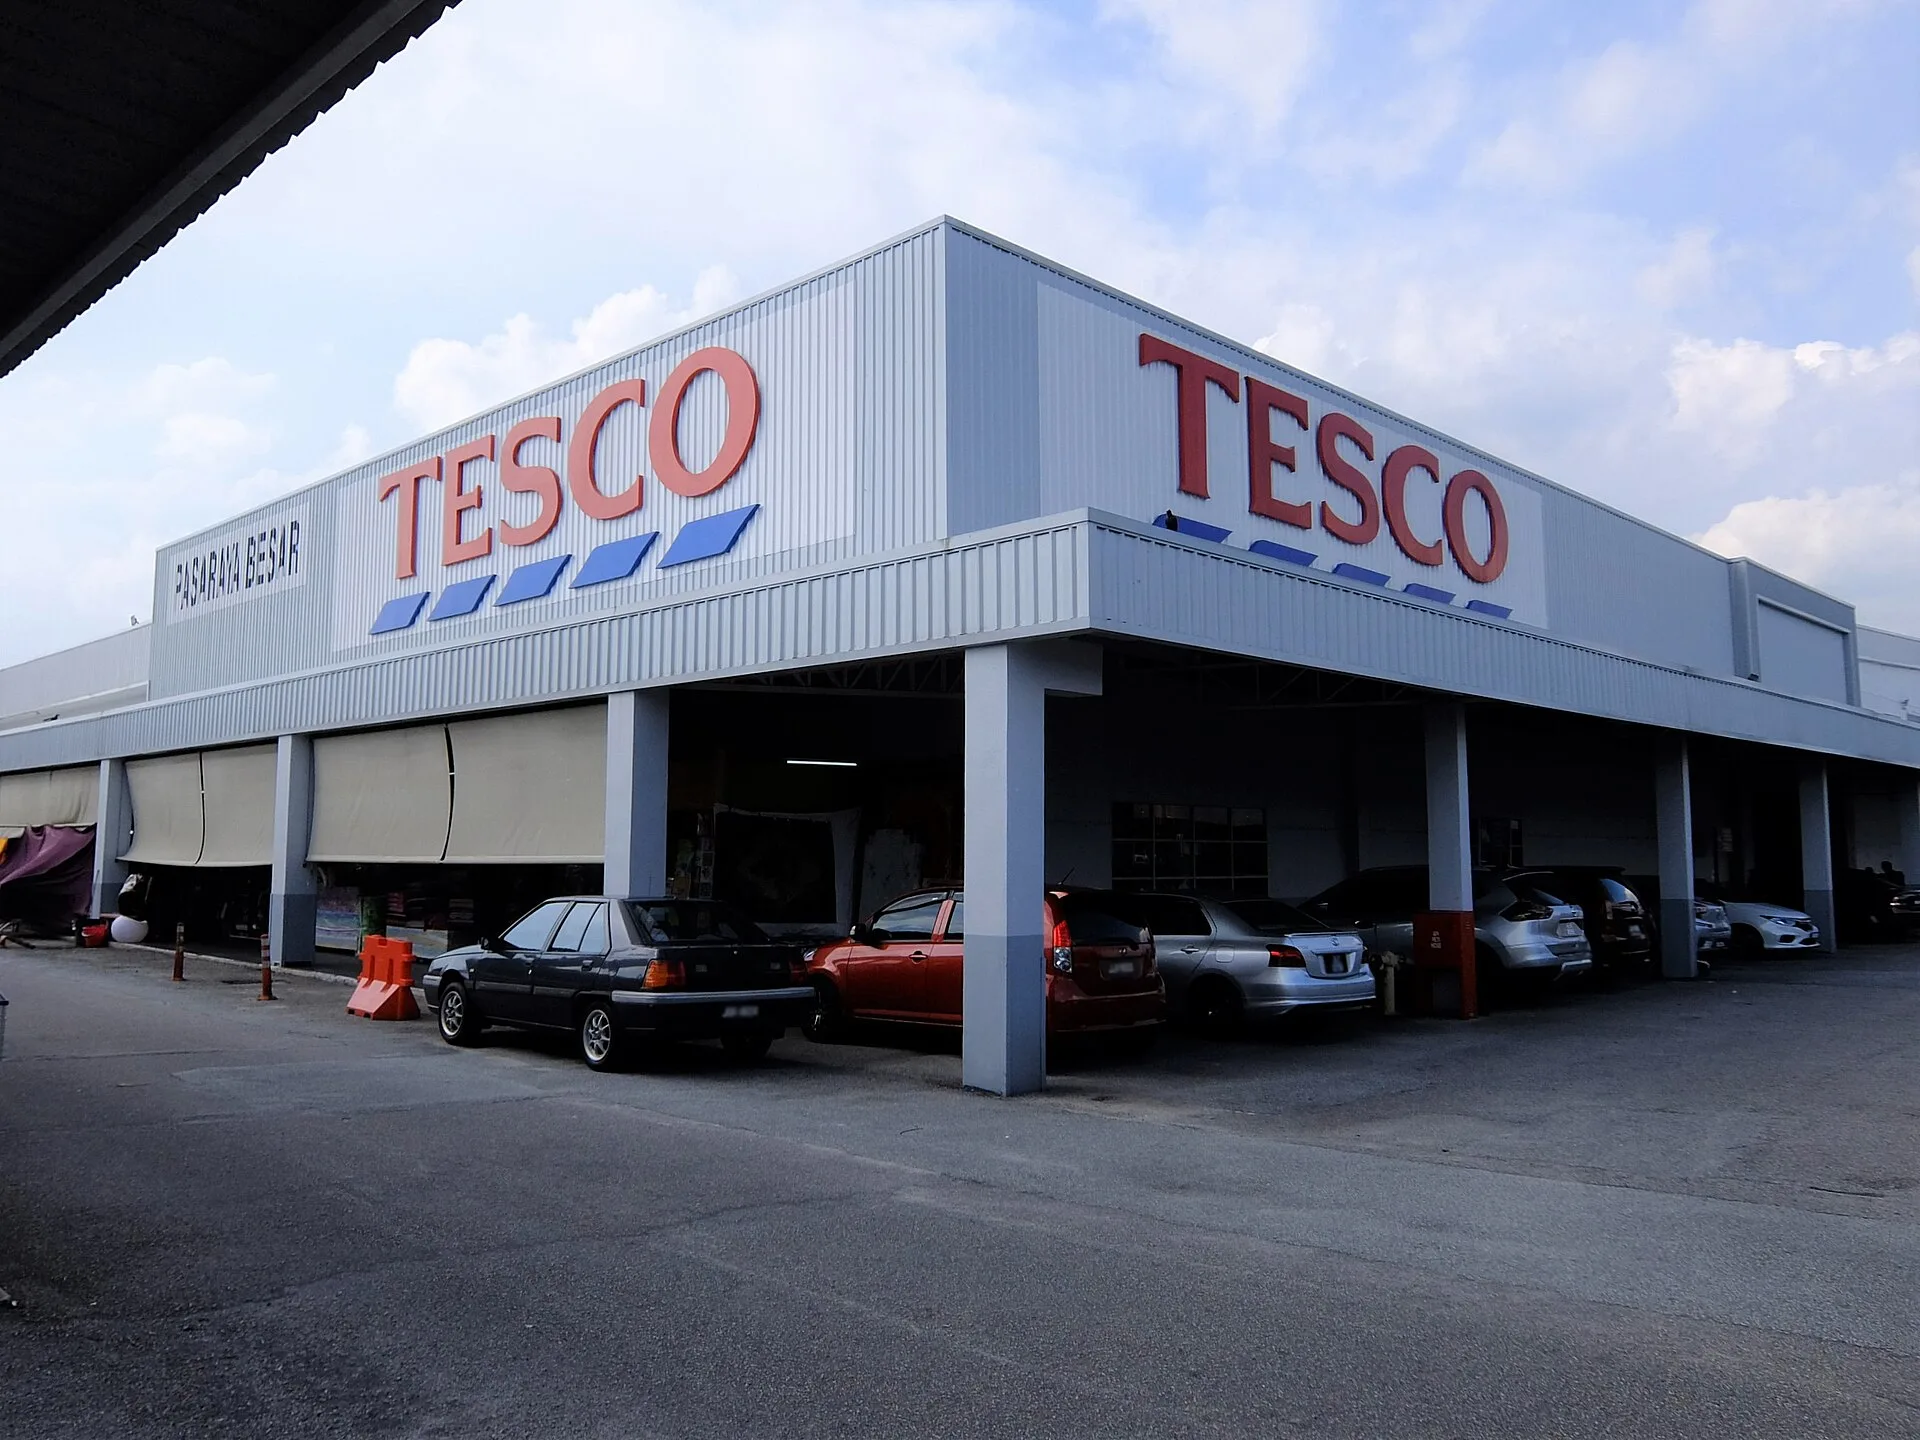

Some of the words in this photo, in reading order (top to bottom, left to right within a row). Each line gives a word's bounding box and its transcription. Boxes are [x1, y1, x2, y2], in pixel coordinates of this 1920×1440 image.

[175, 541, 240, 610] PASARAYA
[245, 520, 300, 589] BESAR
[379, 346, 760, 579] TESCO
[1139, 333, 1509, 583] TESCO
